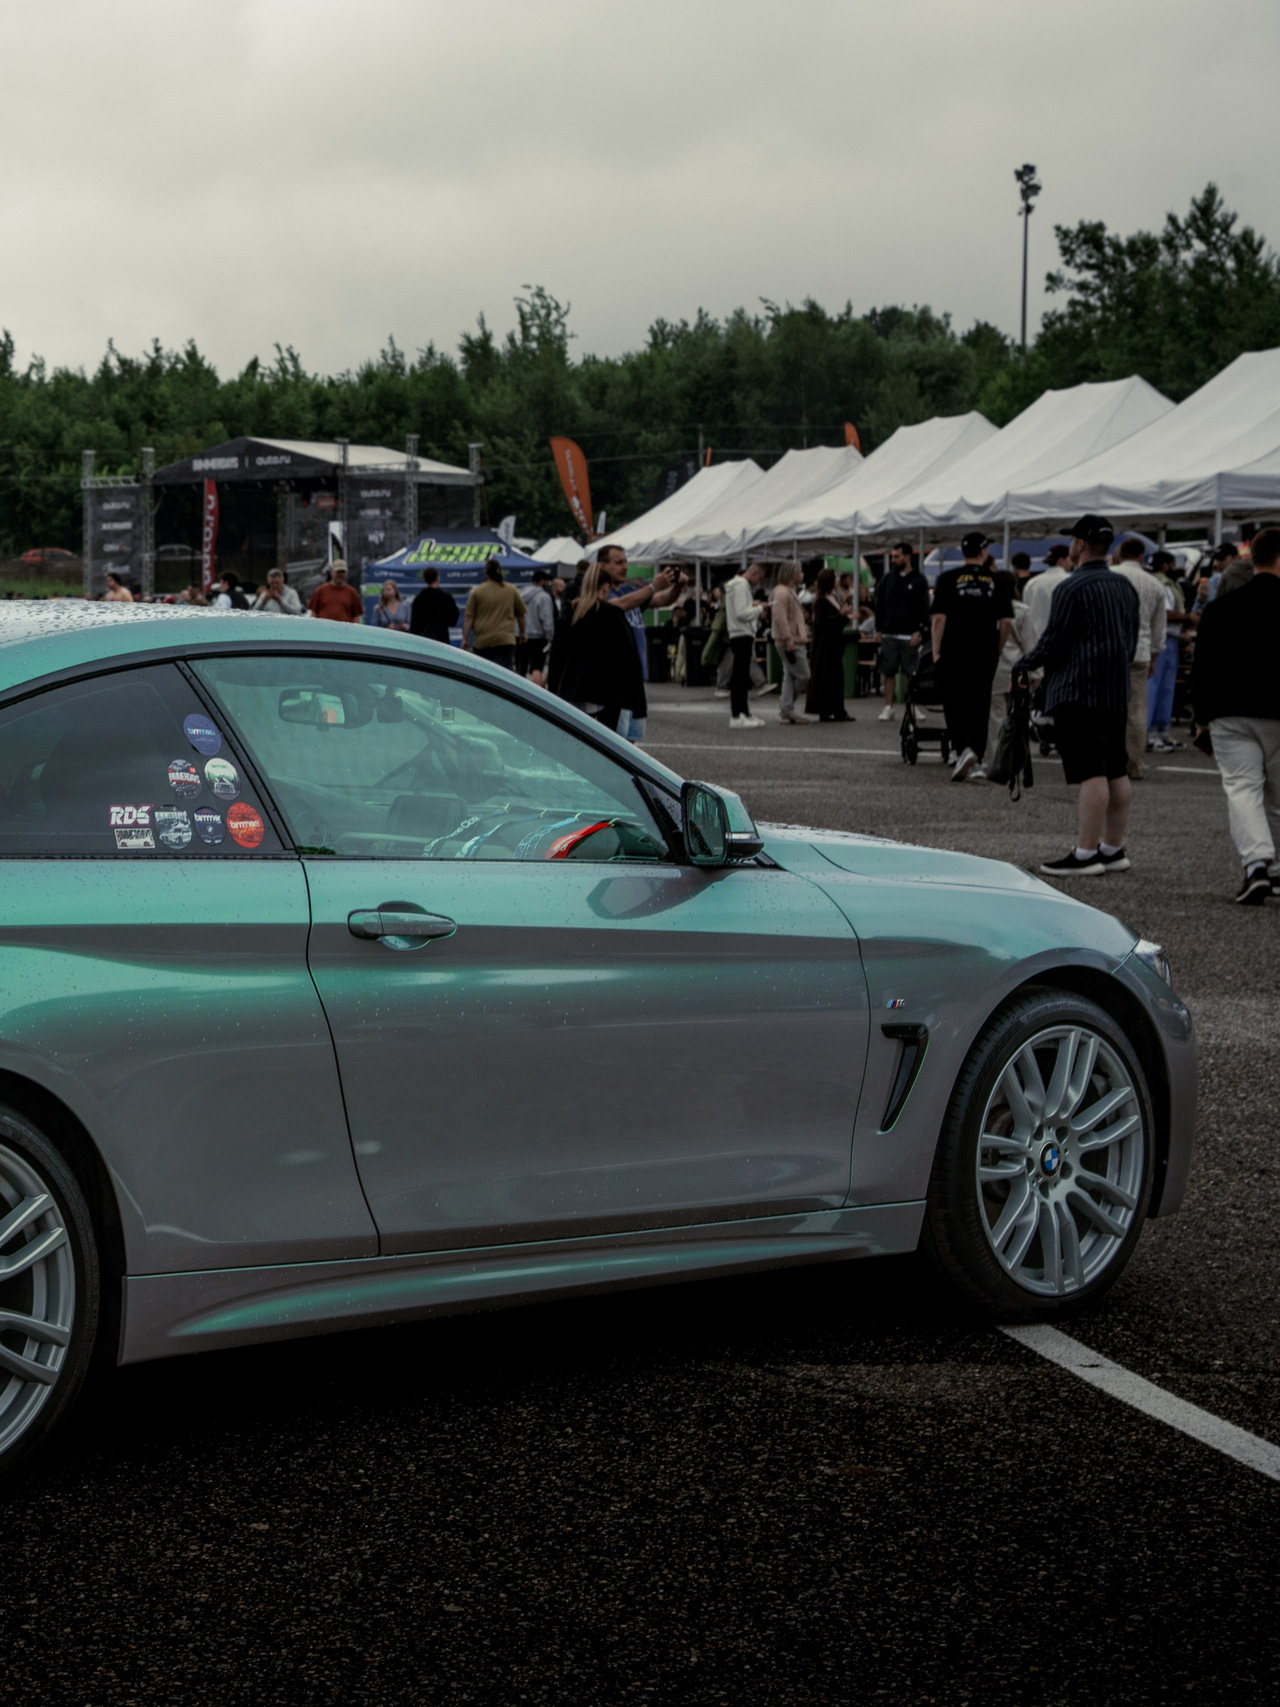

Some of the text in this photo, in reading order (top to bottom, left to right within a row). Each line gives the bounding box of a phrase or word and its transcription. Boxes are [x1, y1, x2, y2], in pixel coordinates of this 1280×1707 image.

[255, 455, 291, 466] auto.ru
[202, 494, 216, 586] auto.ru
[111, 806, 150, 825] RDS
